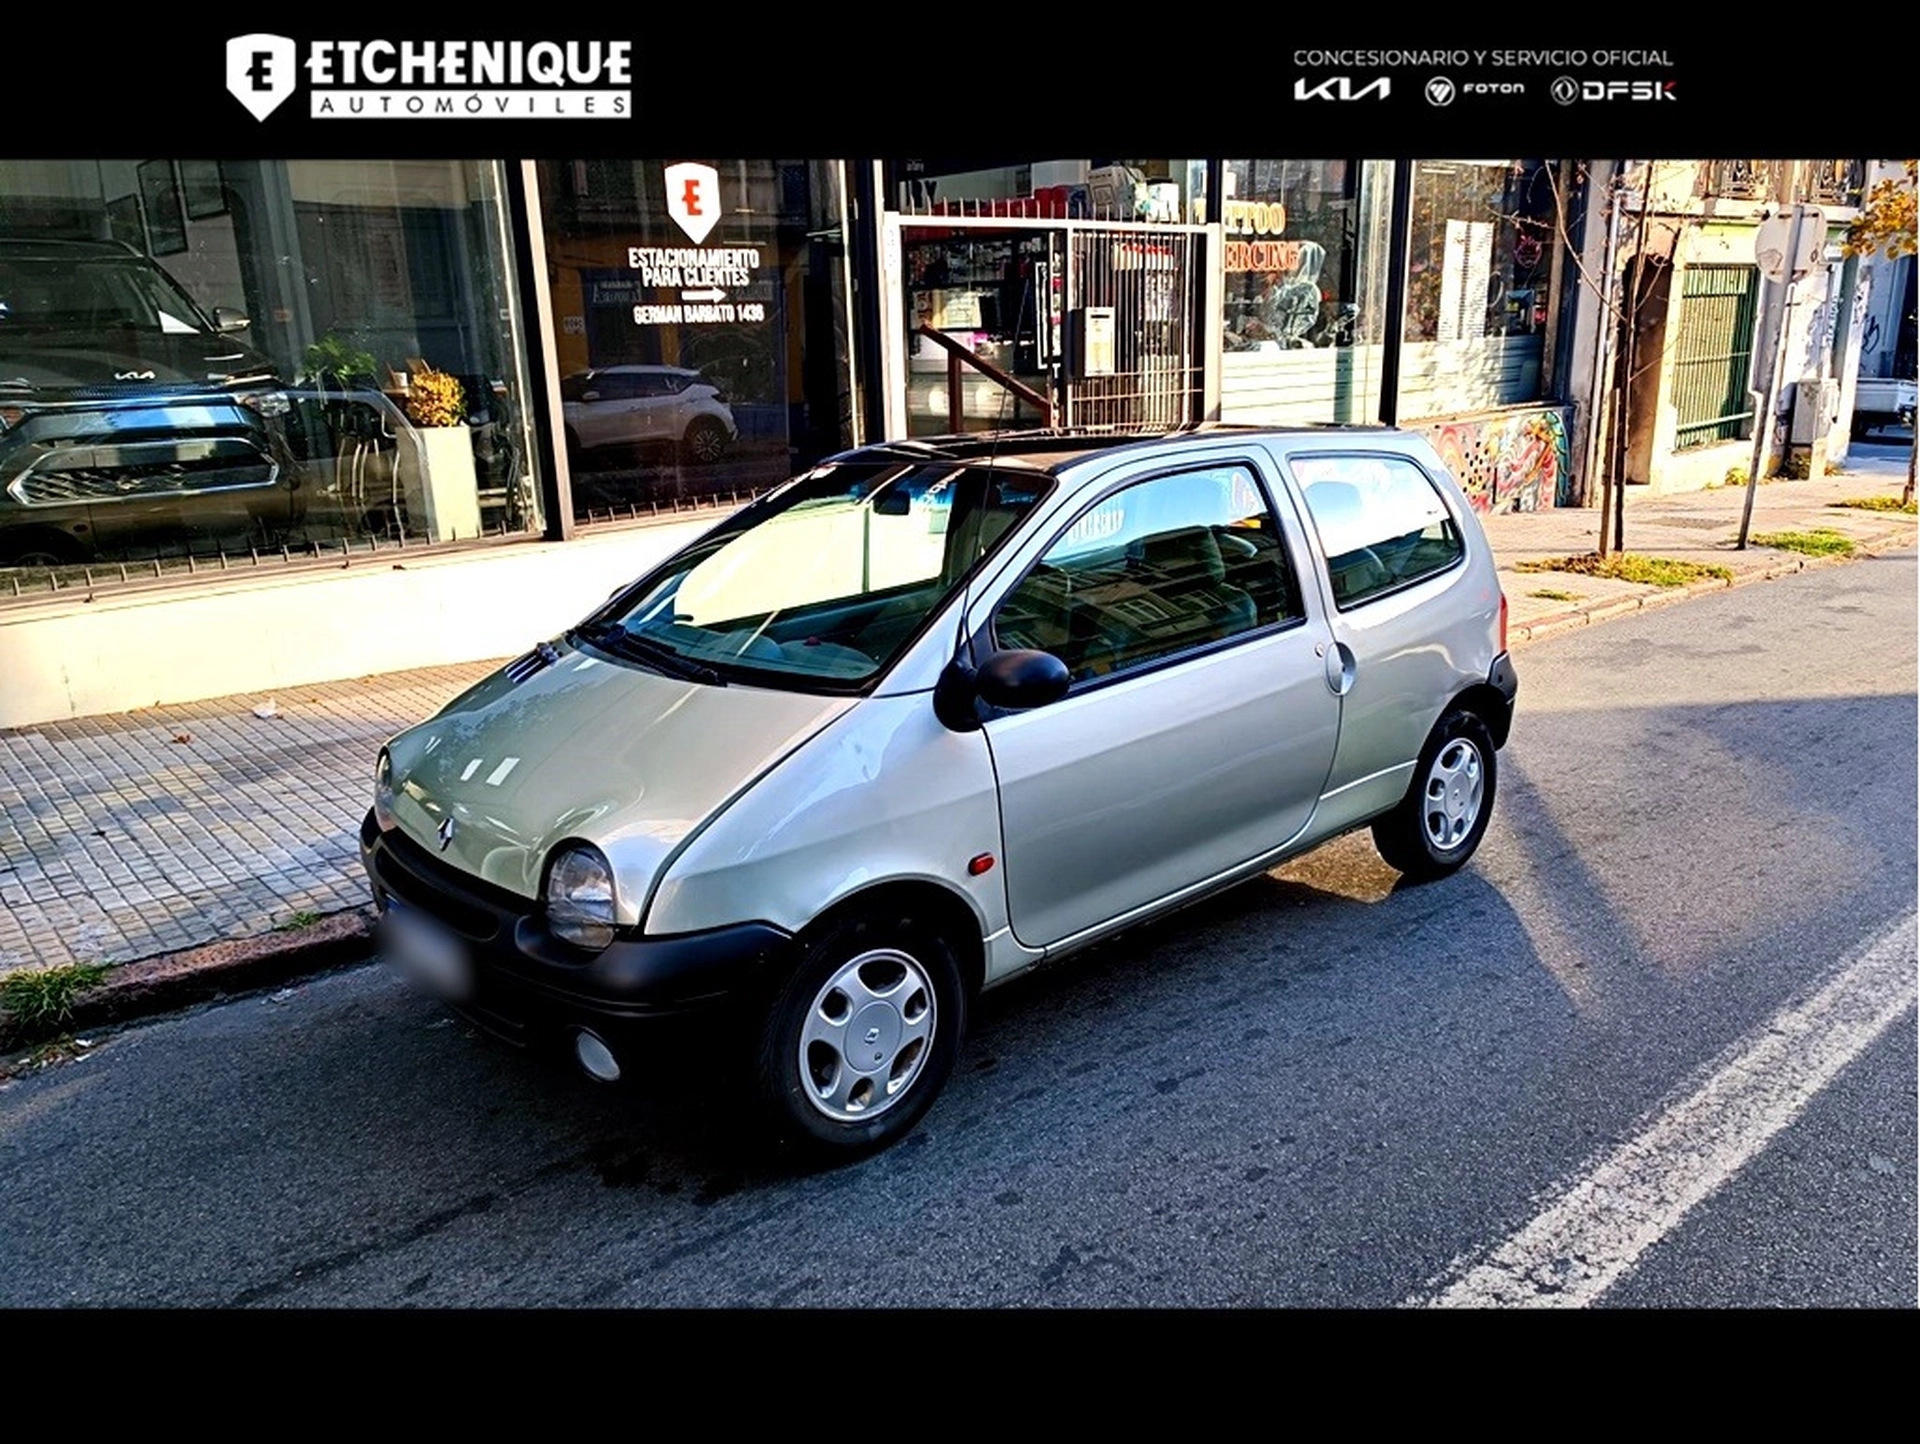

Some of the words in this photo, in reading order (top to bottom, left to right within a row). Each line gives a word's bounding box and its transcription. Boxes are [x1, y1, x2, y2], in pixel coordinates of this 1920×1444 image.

[628, 247, 760, 269] ESTACIONAMIENTO
[642, 266, 683, 287] PARA
[683, 267, 750, 287] CLIENTES
